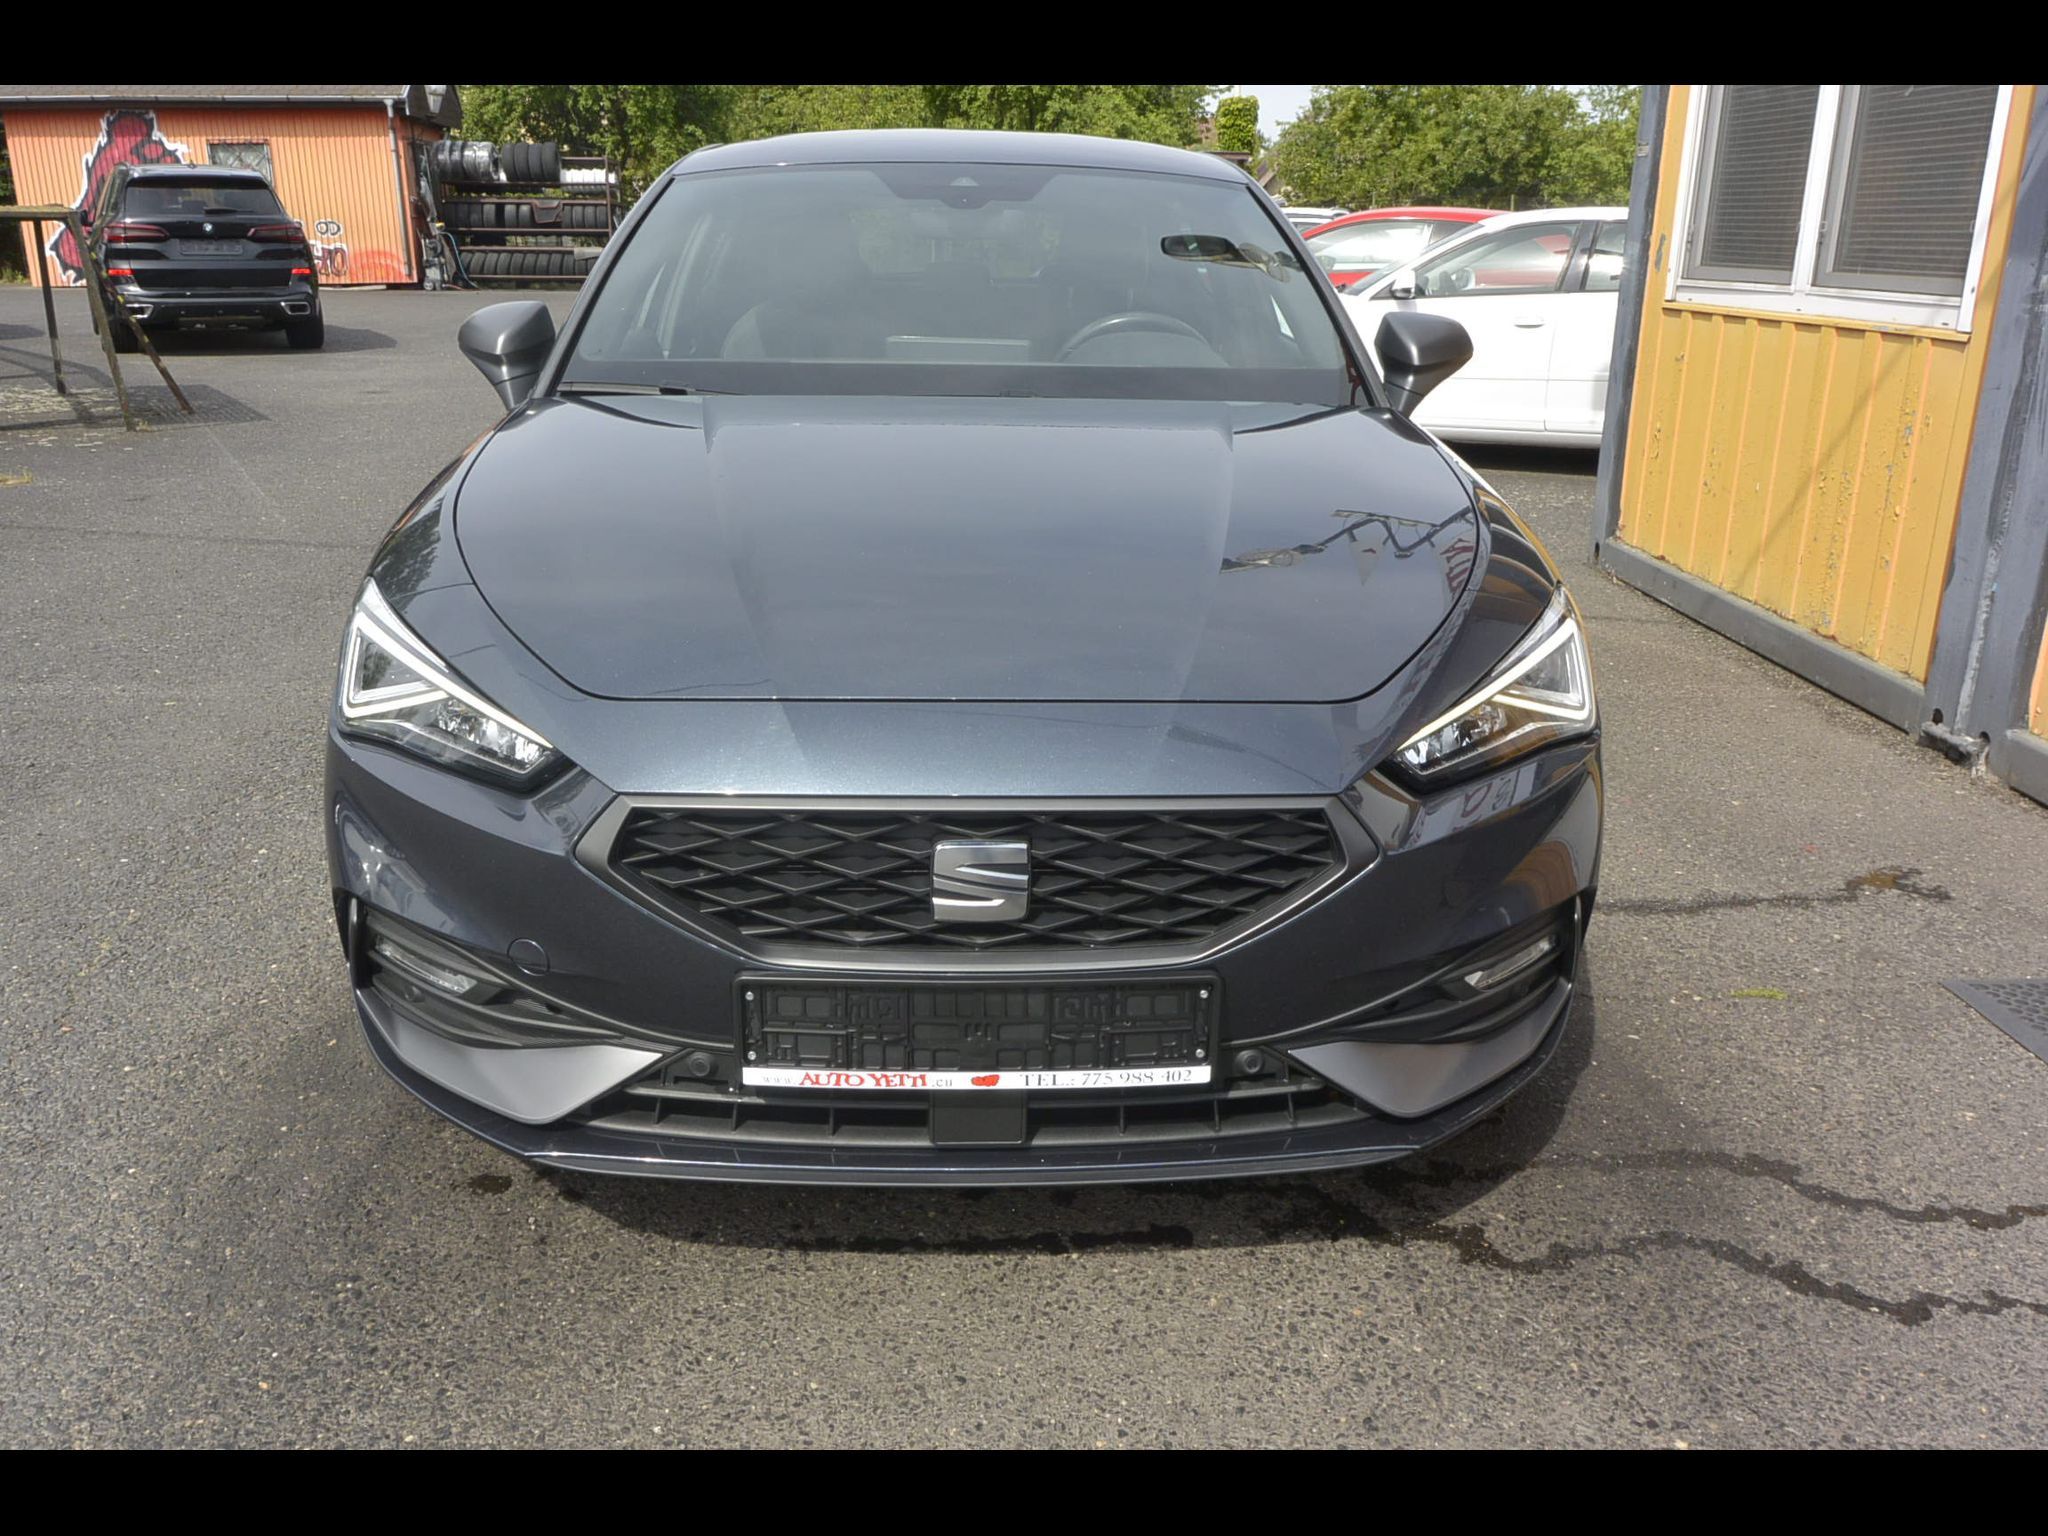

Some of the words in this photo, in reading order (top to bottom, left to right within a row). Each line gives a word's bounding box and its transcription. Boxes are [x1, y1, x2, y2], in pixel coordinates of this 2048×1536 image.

[1082, 1072, 1113, 1086] 775
[1120, 1072, 1153, 1085] 988
[1161, 1069, 1192, 1083] 402
